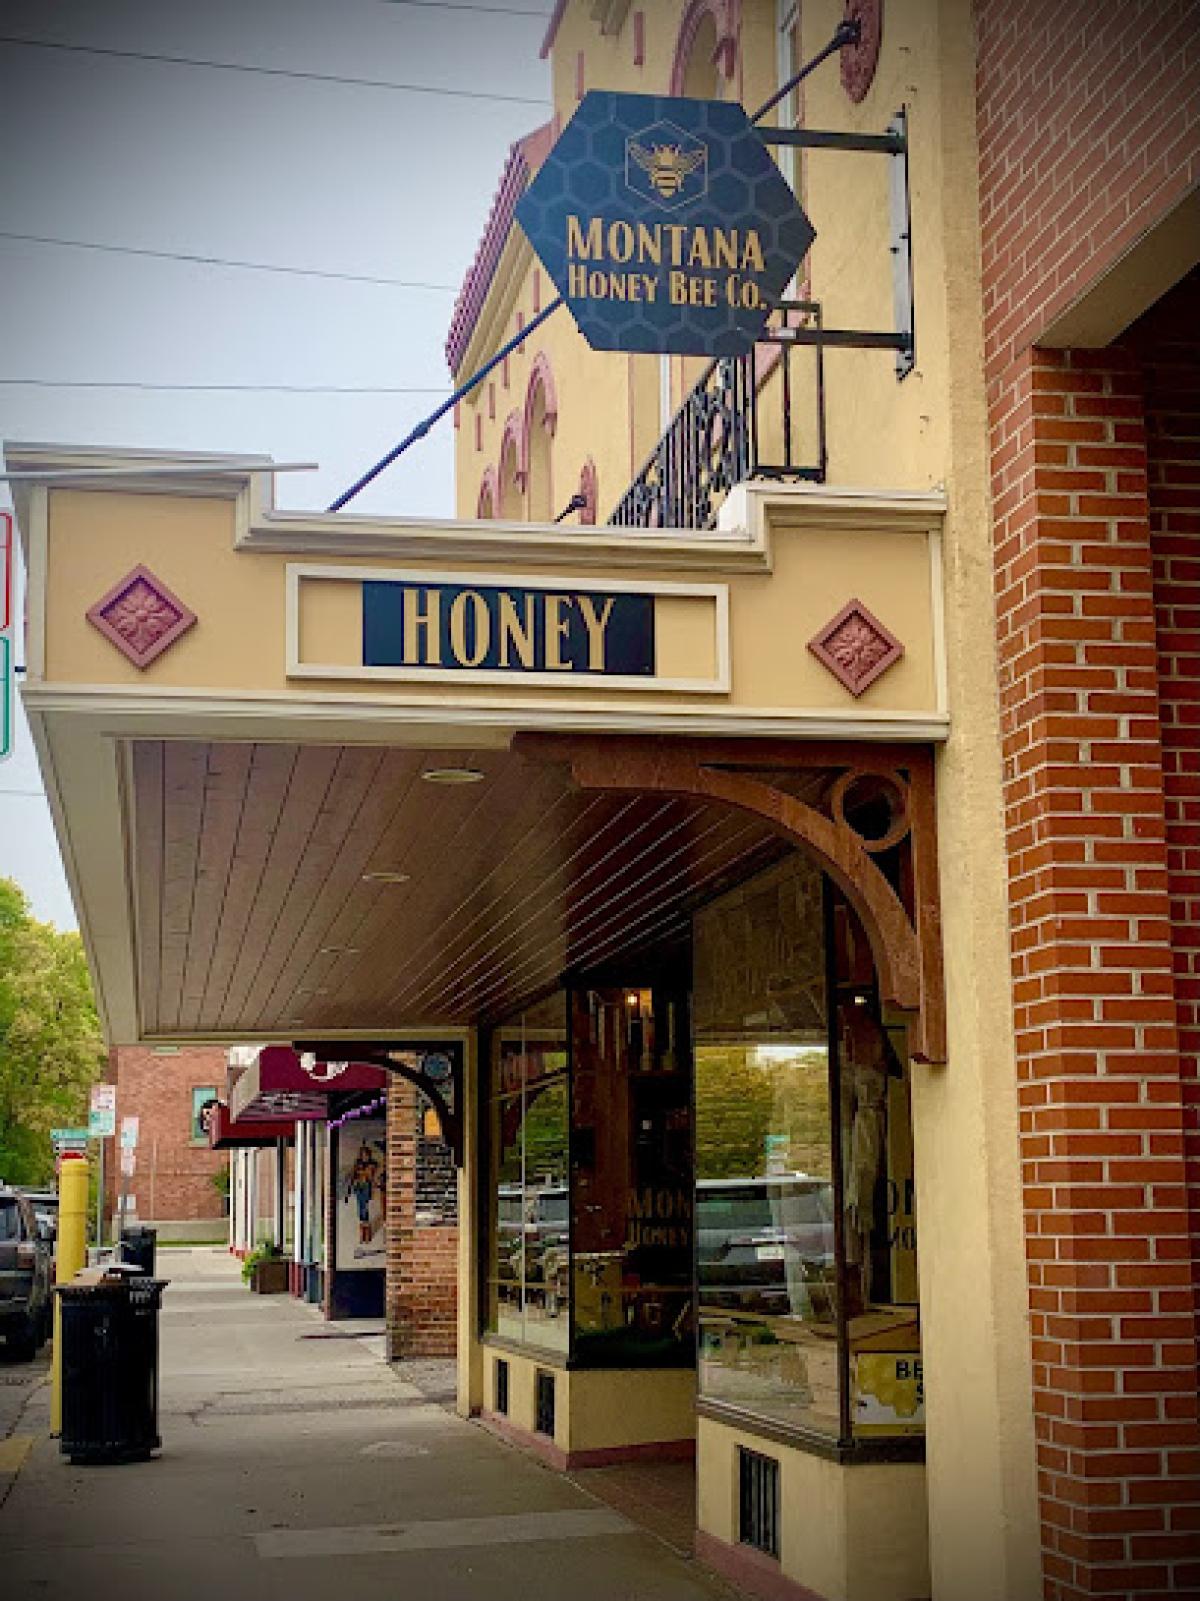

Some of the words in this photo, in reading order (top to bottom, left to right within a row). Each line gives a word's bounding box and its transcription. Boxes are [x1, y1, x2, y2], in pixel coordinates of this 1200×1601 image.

[567, 215, 765, 272] MONTANA
[568, 264, 658, 302] HONEY
[669, 270, 717, 308] BEE
[726, 274, 767, 310] CO.
[402, 589, 615, 670] HONEY
